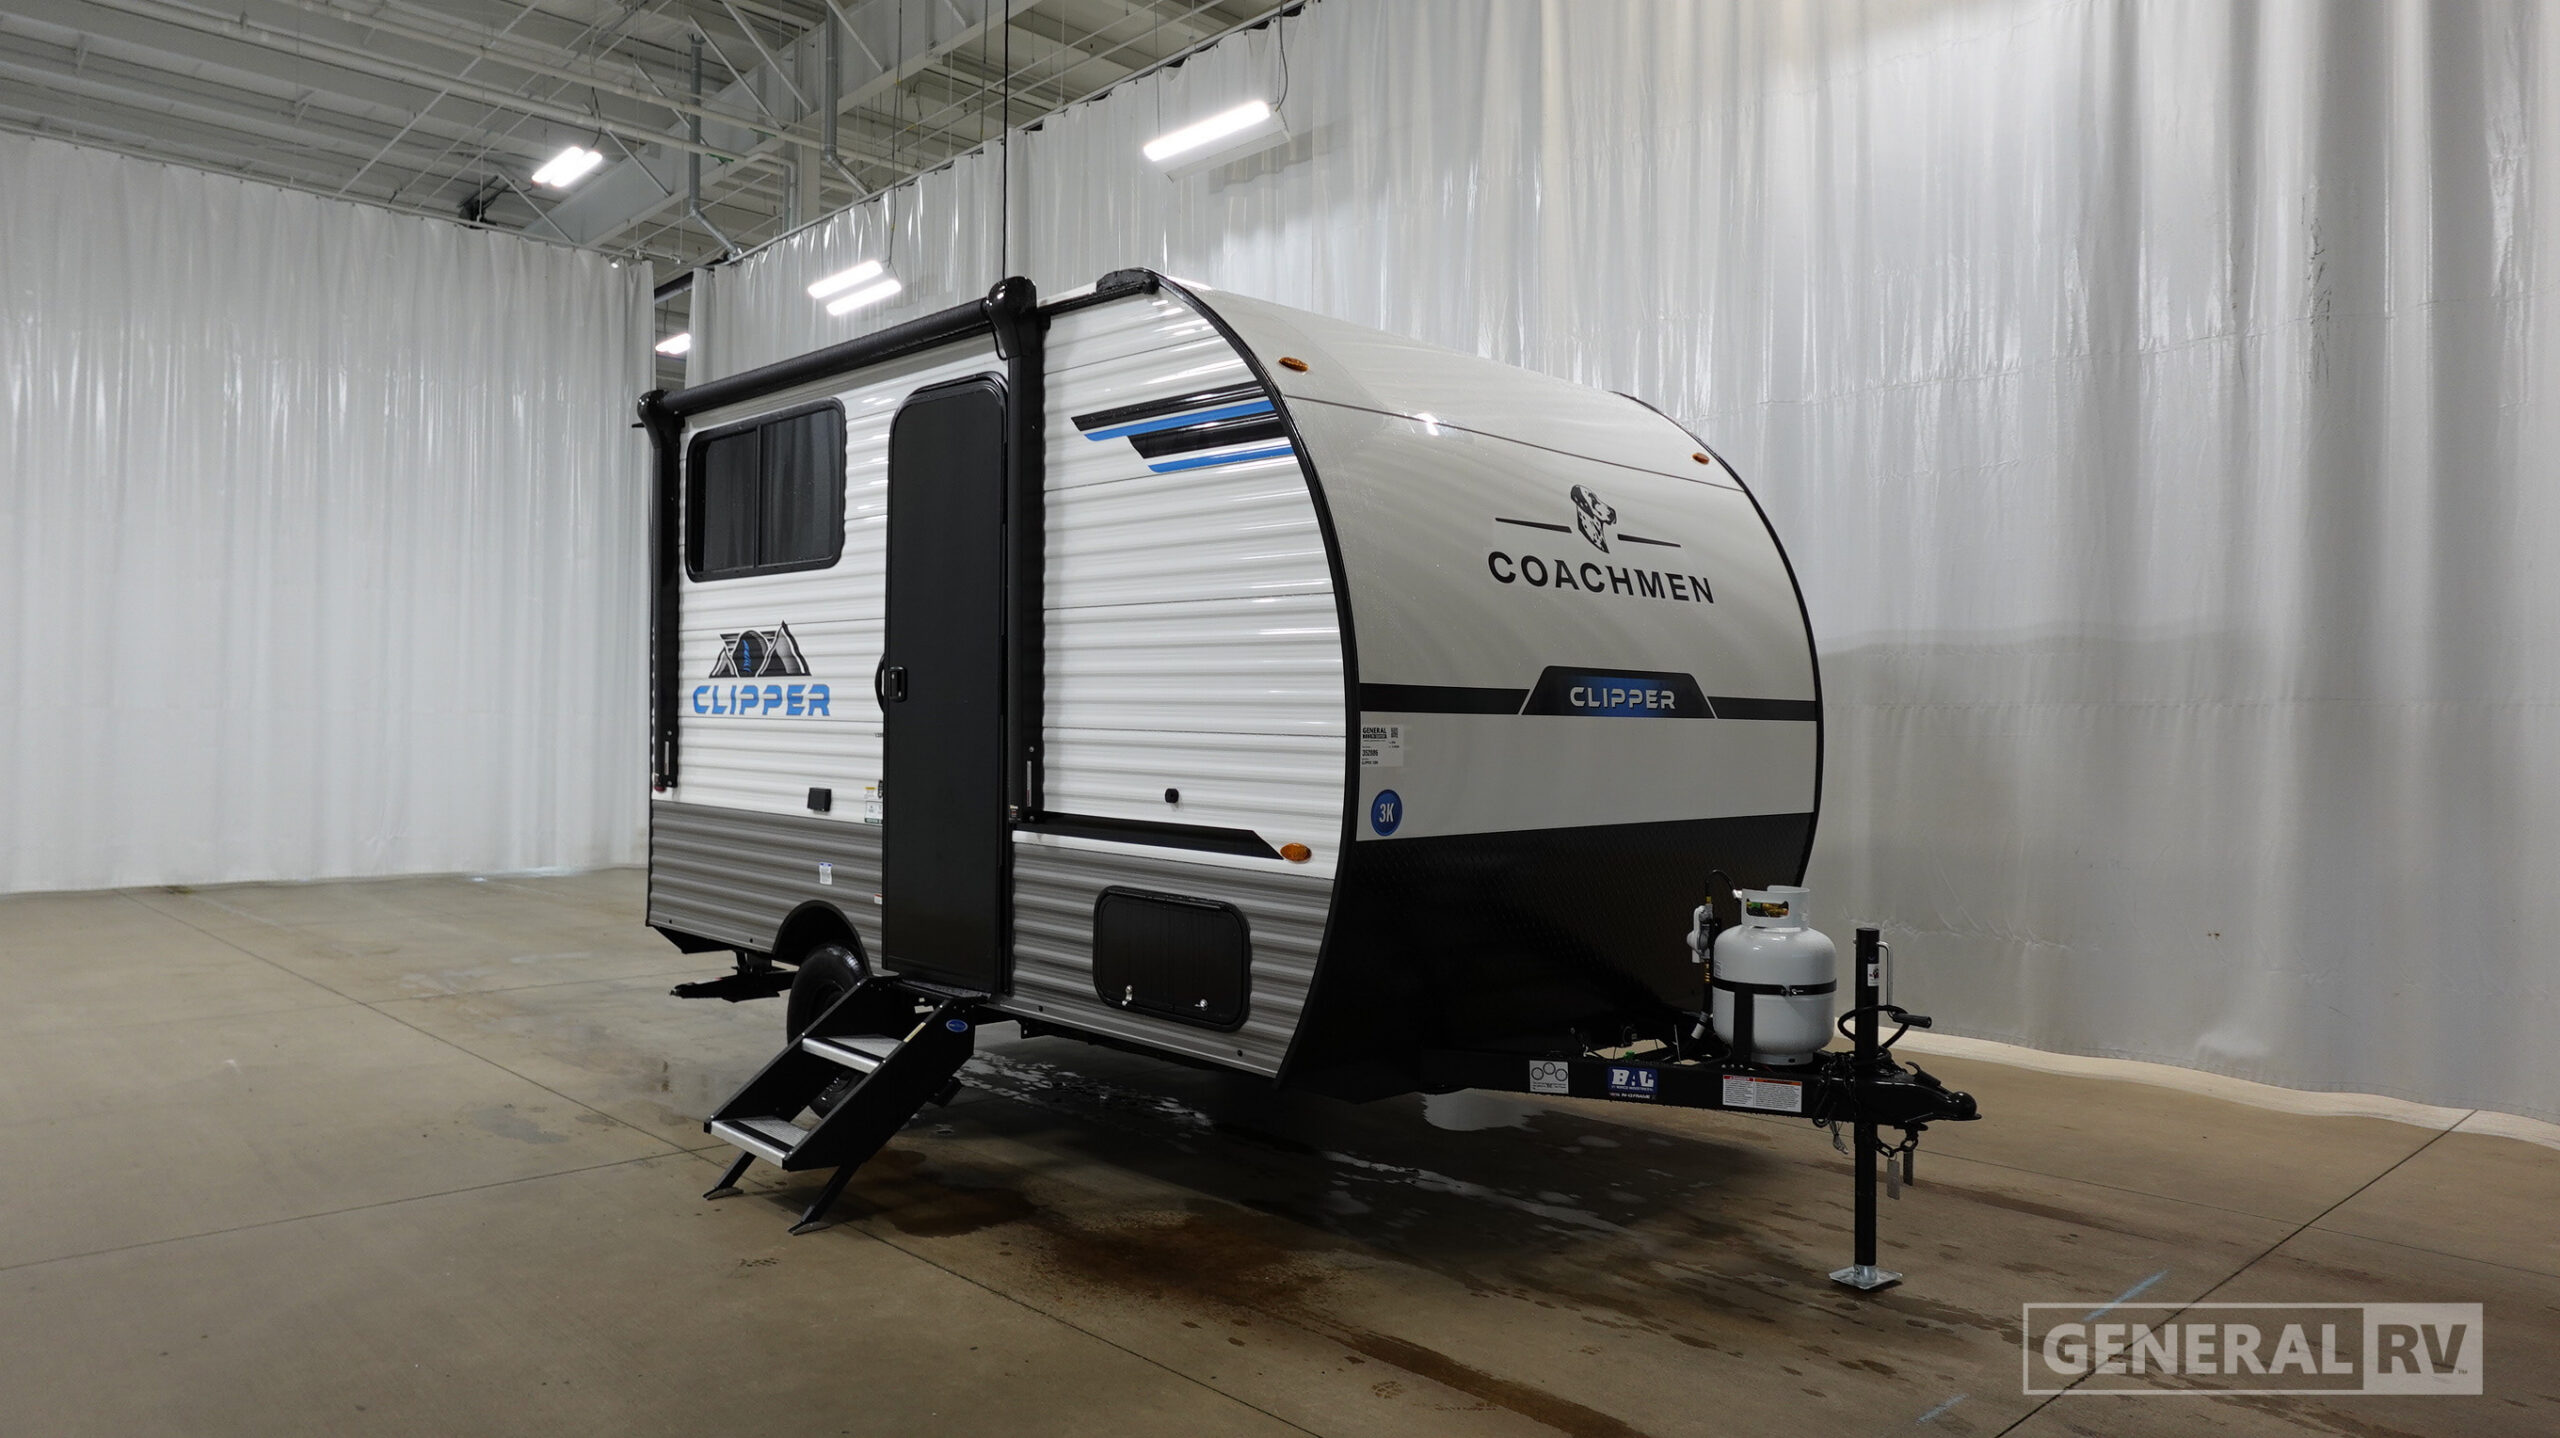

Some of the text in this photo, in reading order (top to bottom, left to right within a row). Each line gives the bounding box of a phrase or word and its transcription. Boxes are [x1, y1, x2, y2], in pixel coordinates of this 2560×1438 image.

[1488, 551, 1714, 604] COACHMEN
[692, 683, 831, 717] CLIPPER
[1569, 686, 1676, 710] CLIPPER
[1379, 803, 1394, 823] 3K
